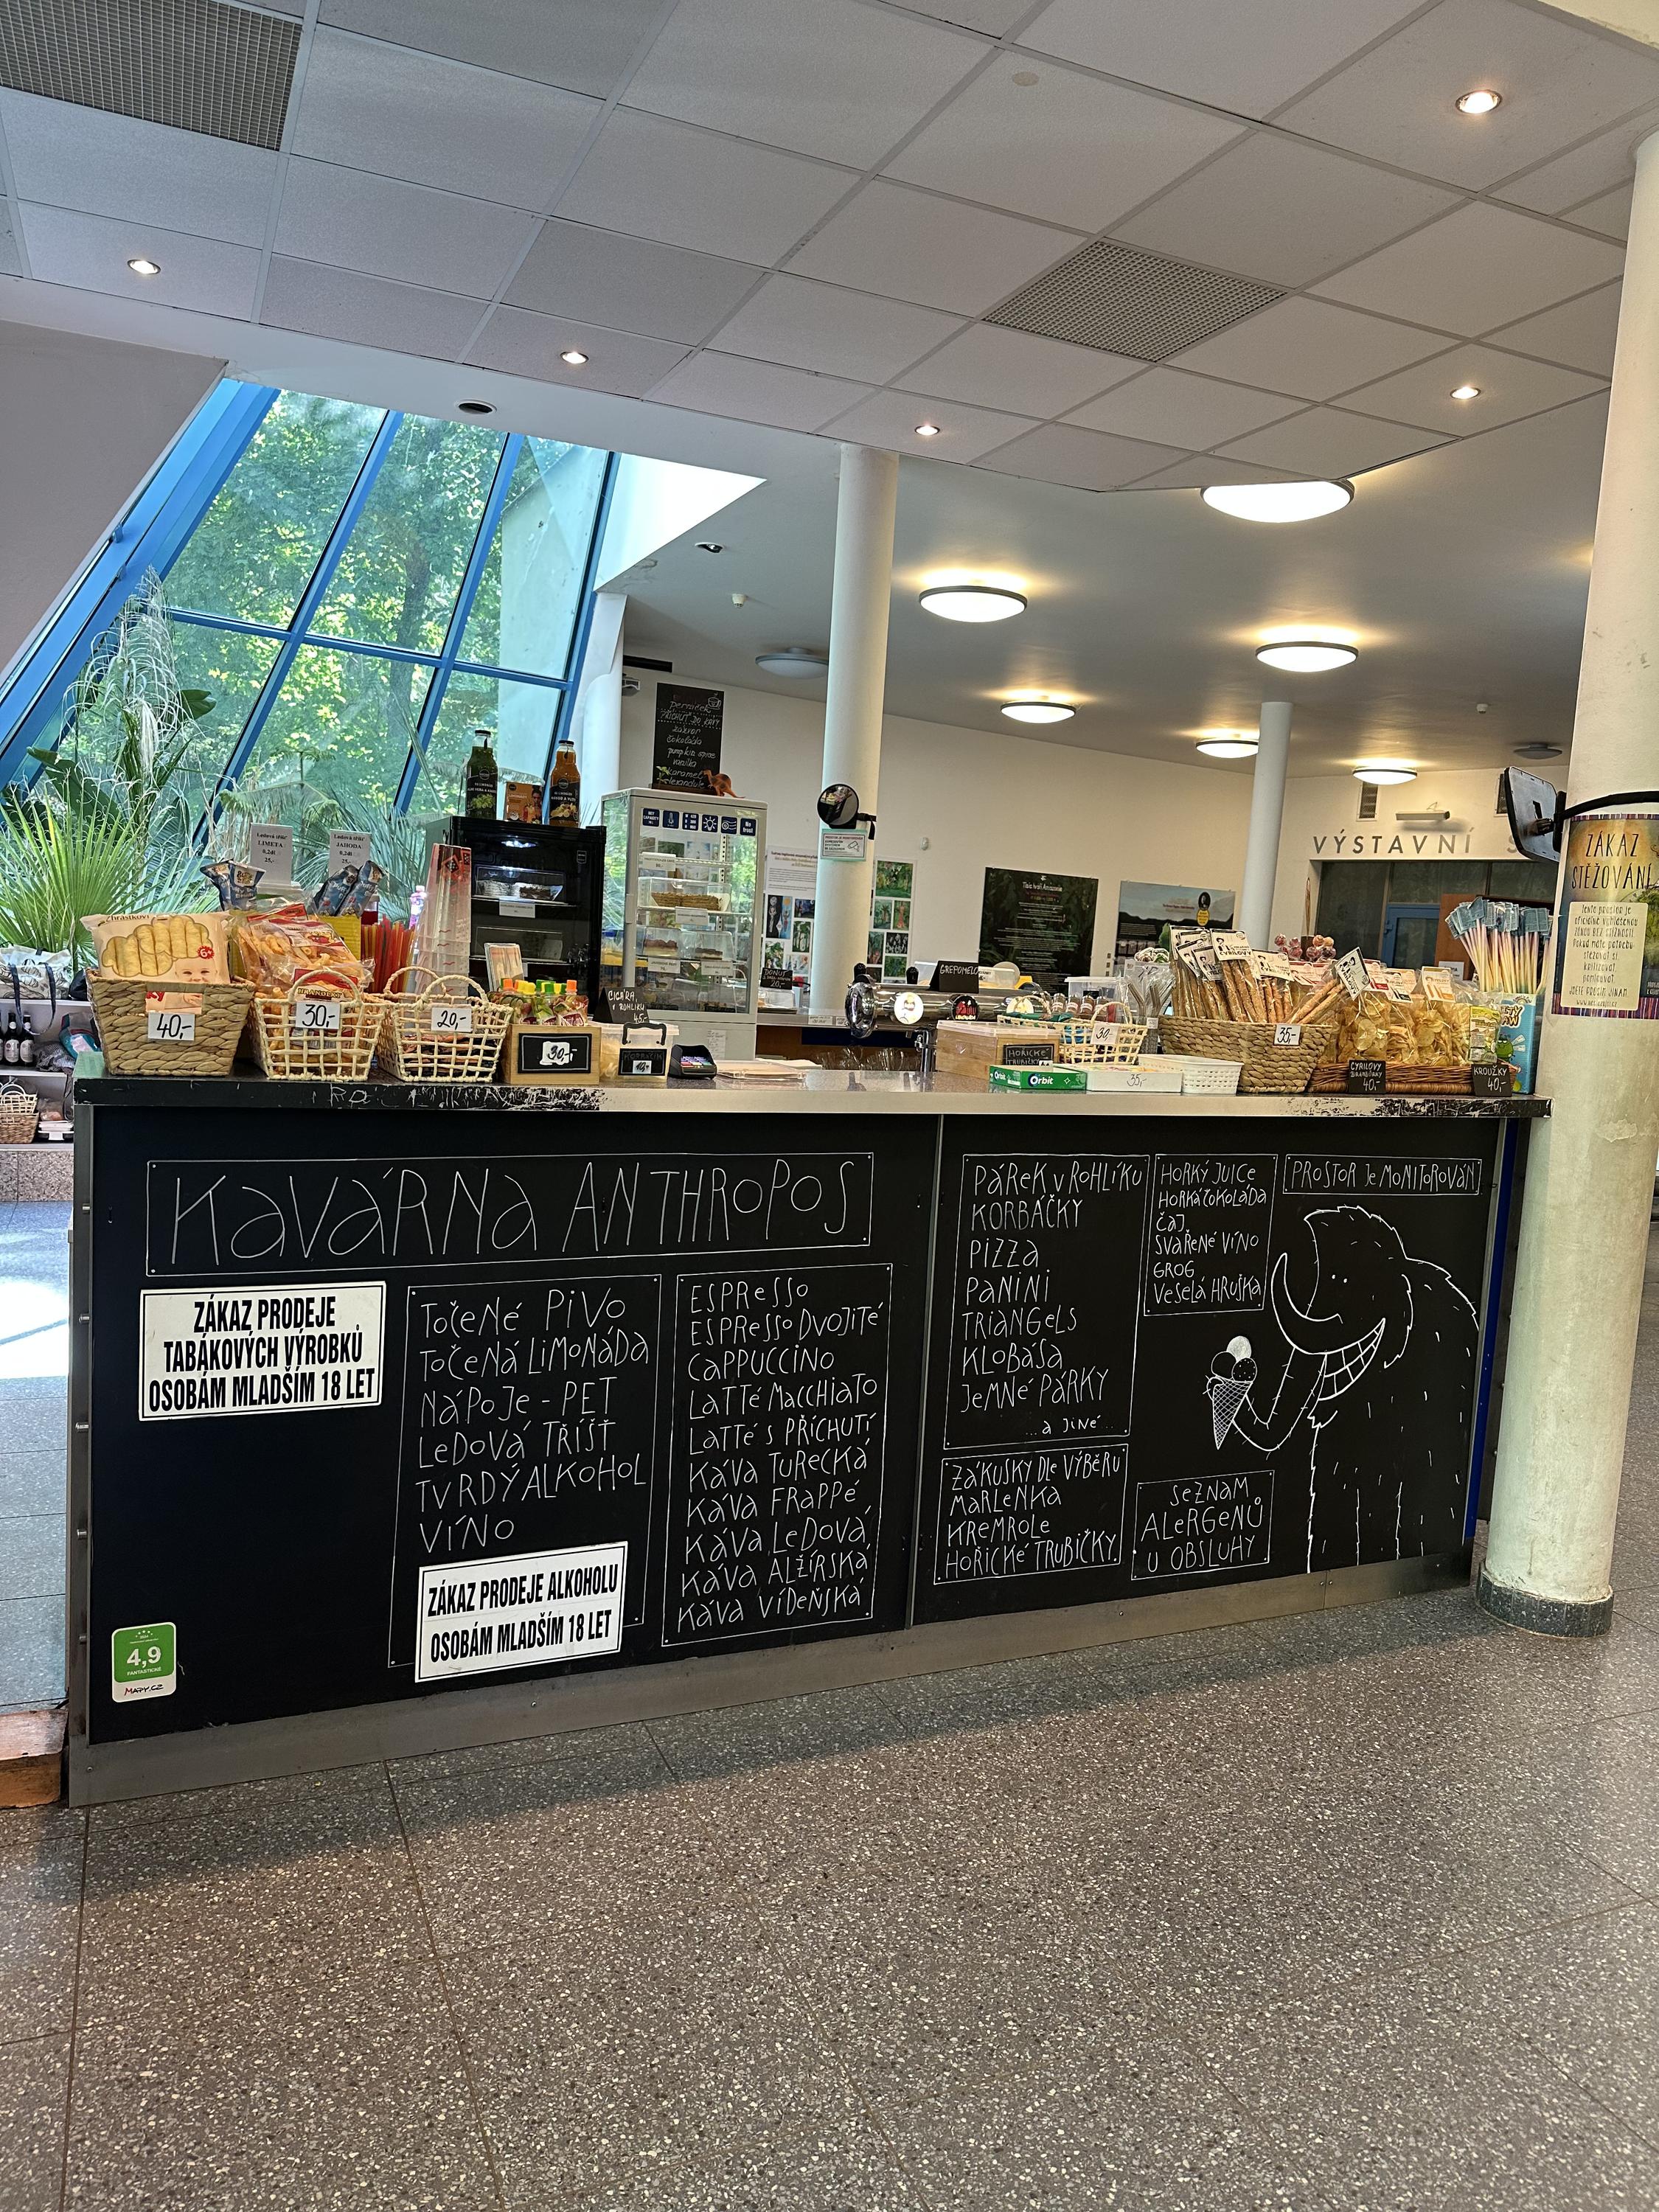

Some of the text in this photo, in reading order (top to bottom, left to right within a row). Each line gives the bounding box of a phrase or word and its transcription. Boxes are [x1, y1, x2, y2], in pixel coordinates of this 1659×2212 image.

[258, 840, 283, 848] LIMETA
[336, 841, 362, 849] JAHODA
[1312, 827, 1475, 854] VÝSTAVNÍ
[1585, 830, 1639, 858] ZÁKAZ
[1571, 862, 1652, 890] STĚŽOVÁNÍ
[1593, 927, 1604, 937] BEZ
[939, 964, 979, 975] GREPOMELO
[297, 987, 343, 999] HRANOLKY
[302, 1004, 335, 1028] 30,-
[437, 1010, 467, 1031] 20,-
[156, 1013, 192, 1040] 40,-
[1096, 1026, 1113, 1041] 30,-
[1276, 1027, 1297, 1044] 35,-
[636, 1061, 649, 1073] 10,-
[995, 1071, 1006, 1080] Orbit
[1350, 1062, 1382, 1071] CYRILOVY
[1473, 1066, 1507, 1077] KROUŽKY
[1029, 1075, 1054, 1087] Orbit
[1126, 1073, 1147, 1088] 35,-
[1363, 1078, 1380, 1092] 40,-
[1487, 1077, 1507, 1093] 40,-
[562, 1158, 855, 1253] ANTHROPOS
[970, 1193, 1083, 1232] KORBÁČKY
[1152, 1259, 1194, 1279] GROG
[193, 1294, 336, 1334] ZÁKAZ PRODEJE
[164, 1324, 364, 1373] TABÁKOVÝCH VÝROBKŮ
[148, 1366, 376, 1413] OSOBÁM MLADŠÍM 18 LET
[562, 1377, 618, 1416] PET
[415, 1463, 520, 1513] TVRDÝ
[1147, 1534, 1256, 1573] U OBSLUHY
[428, 1563, 619, 1617] ZÁKAZ PRODEJE ALKOHOLU
[430, 1609, 612, 1663] OSOBÁM MLADŠÍM 18 LET
[126, 1646, 161, 1669] 4,9
[126, 1666, 162, 1676] FANTASTICKÉ
